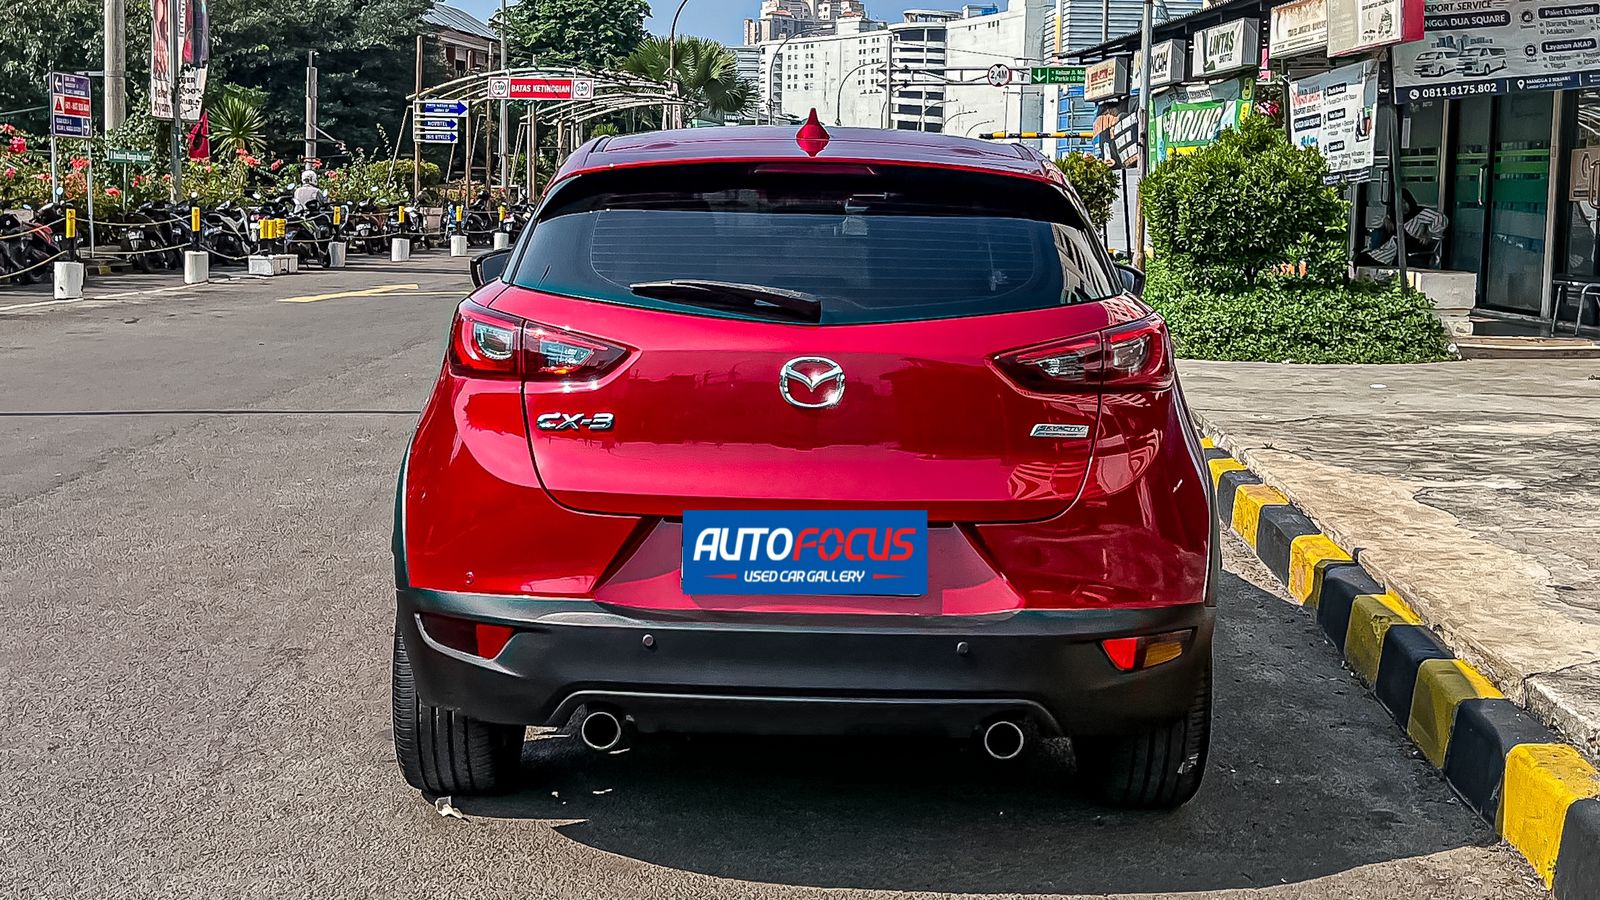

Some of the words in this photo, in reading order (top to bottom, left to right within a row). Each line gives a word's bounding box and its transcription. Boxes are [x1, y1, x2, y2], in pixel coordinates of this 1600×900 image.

[1457, 1, 1492, 11] SERVICE
[1450, 18, 1470, 26] DUA
[1471, 14, 1506, 25] SQUARE
[1209, 30, 1235, 57] LINTAS
[1545, 42, 1572, 51] Layanan
[1572, 40, 1592, 48] AKAP
[511, 85, 531, 93] BATAS
[532, 85, 571, 93] KETINGGIAN
[1422, 83, 1497, 98] 0811.8175.802
[537, 411, 615, 430] CX-3
